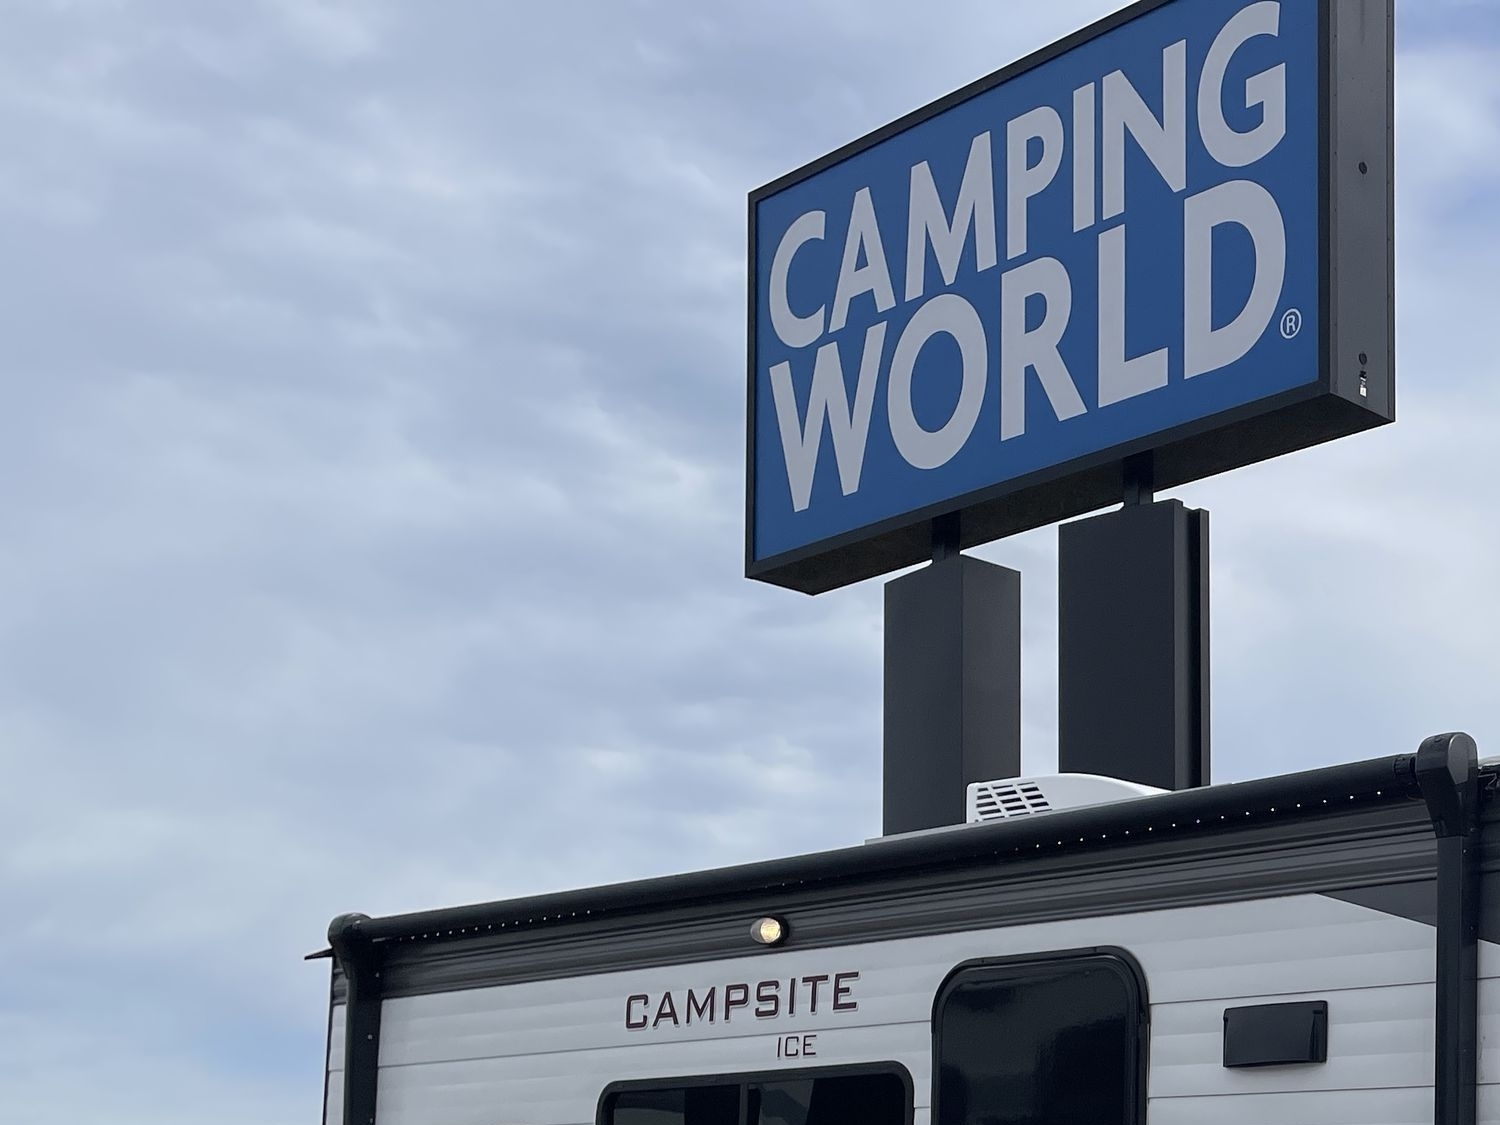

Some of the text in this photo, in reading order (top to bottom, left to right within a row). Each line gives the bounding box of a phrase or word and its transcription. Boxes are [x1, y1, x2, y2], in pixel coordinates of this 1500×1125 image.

[768, 0, 1287, 349] CAMPING
[768, 179, 1286, 512] WORLD
[625, 971, 860, 1030] CAMPSITE
[777, 1034, 817, 1058] ICE
